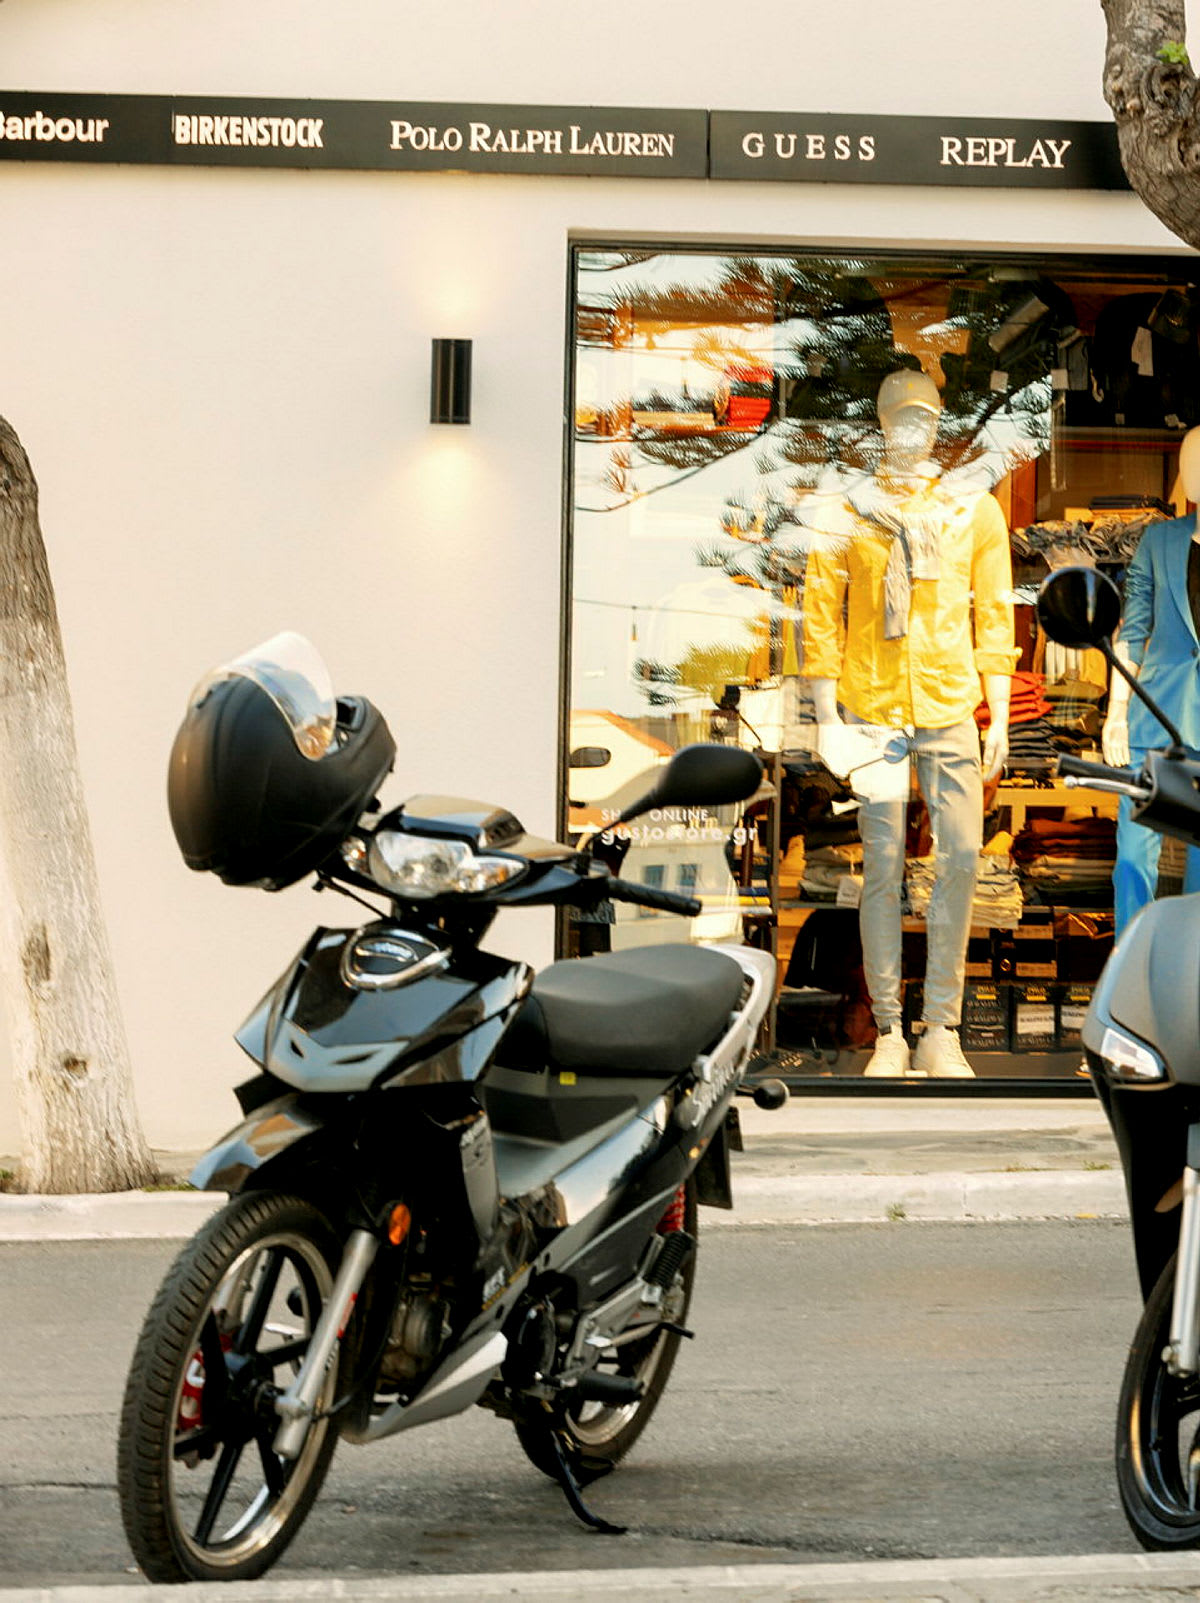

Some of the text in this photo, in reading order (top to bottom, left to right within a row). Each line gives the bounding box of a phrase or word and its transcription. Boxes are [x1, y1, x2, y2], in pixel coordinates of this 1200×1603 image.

[0, 111, 109, 142] arbour
[175, 115, 323, 147] BIRKENSTOCK
[390, 120, 674, 157] POLO RALPH LAUREN
[742, 132, 876, 160] GUESS
[940, 137, 1071, 168] REPLAY
[649, 808, 709, 822] ONLINE
